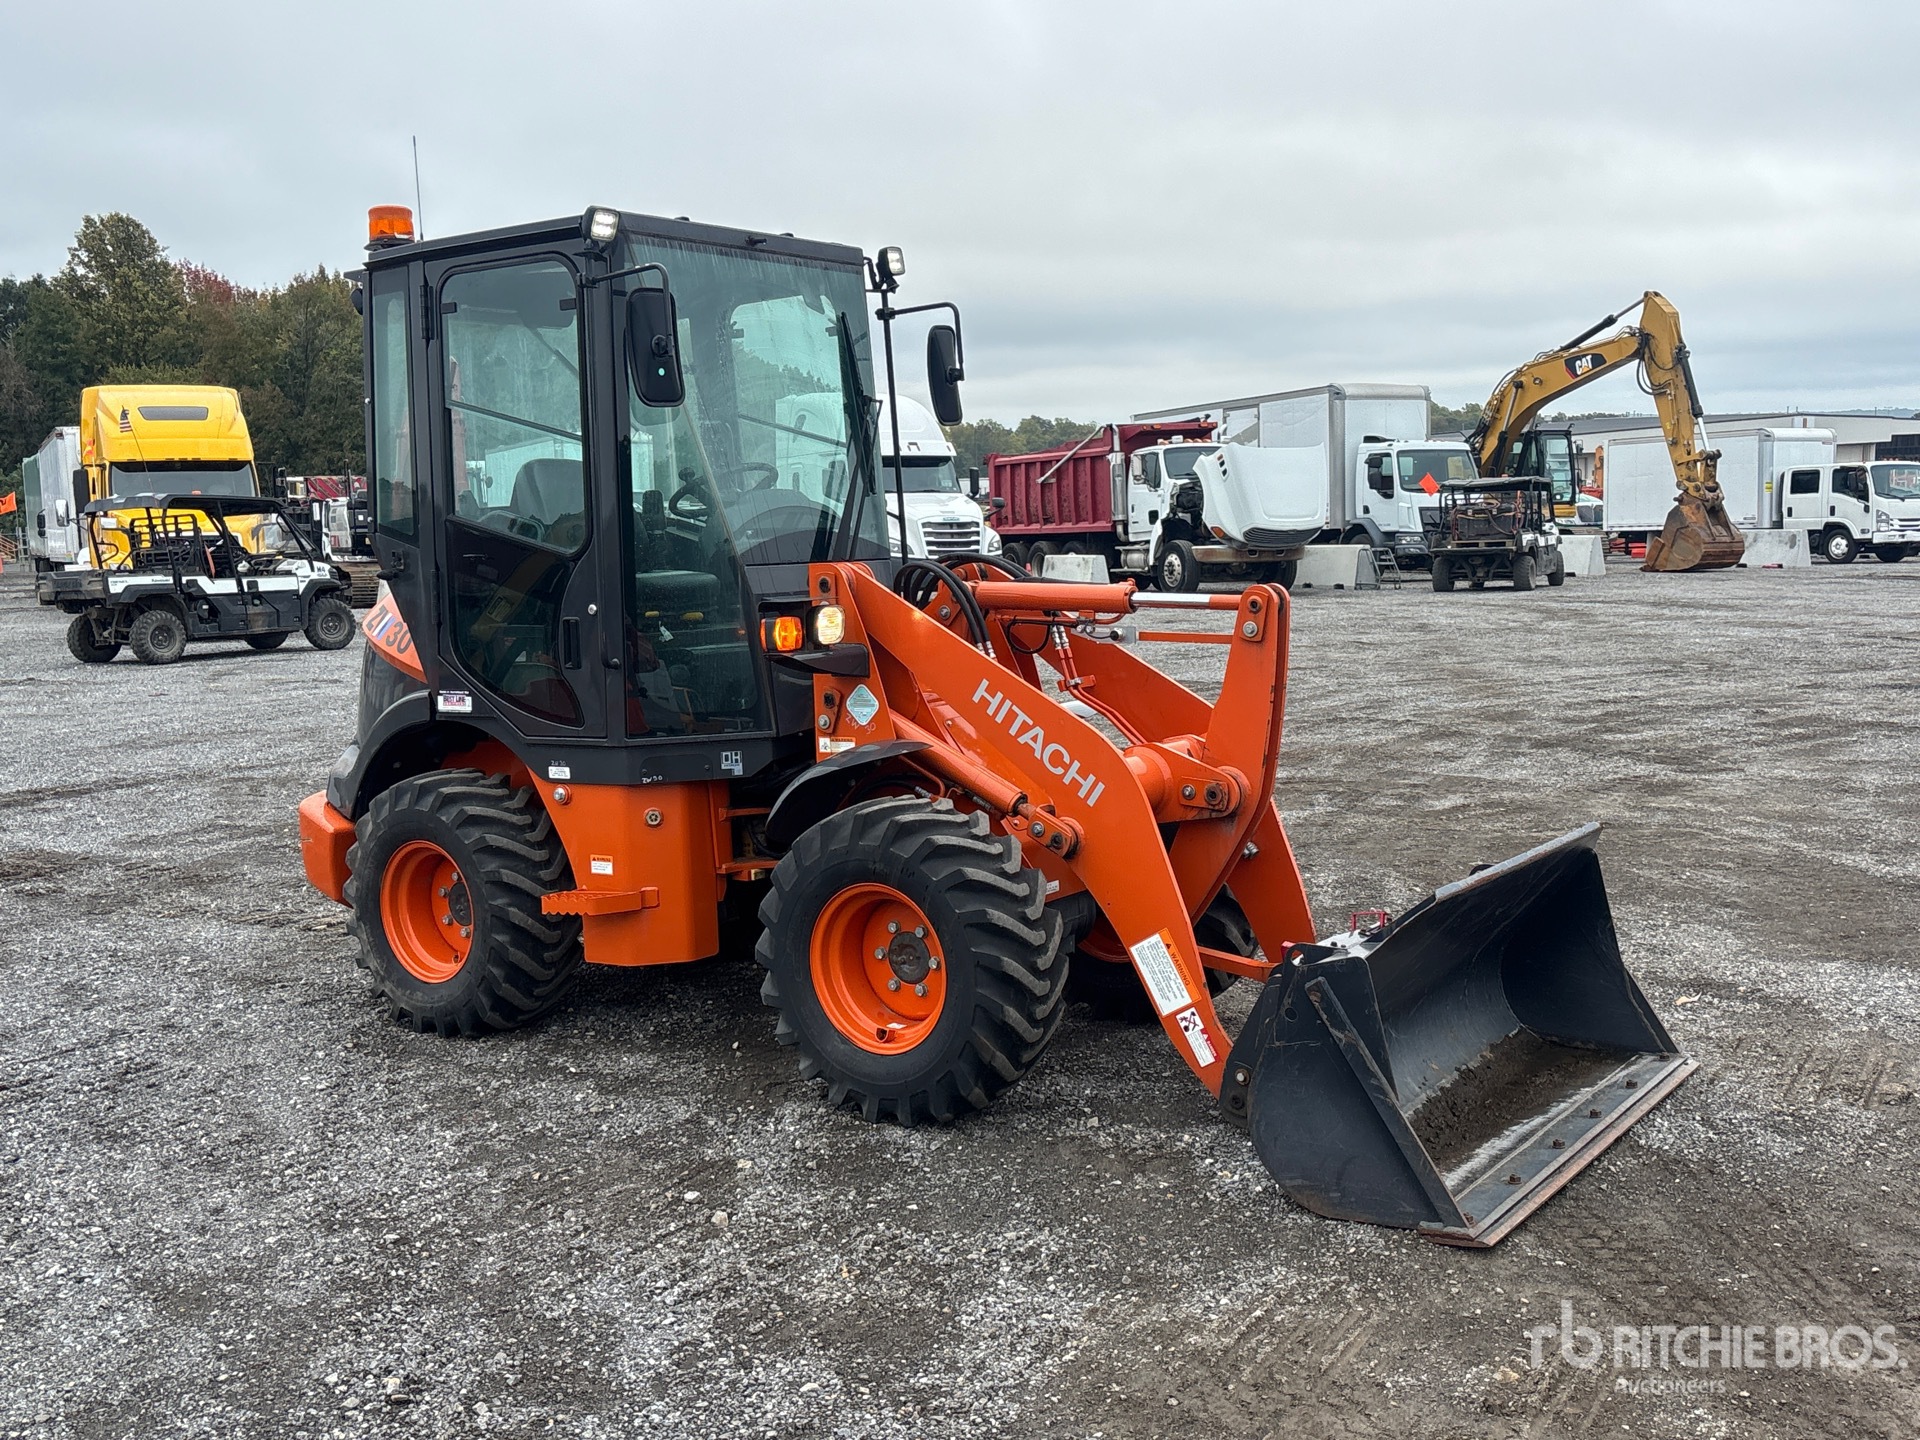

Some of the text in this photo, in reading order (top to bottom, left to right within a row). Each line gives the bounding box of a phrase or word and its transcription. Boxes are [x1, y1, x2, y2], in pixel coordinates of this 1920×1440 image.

[1575, 355, 1593, 375] CAT
[971, 678, 1105, 808] HITACHI
[1171, 952, 1190, 986] WARNING
